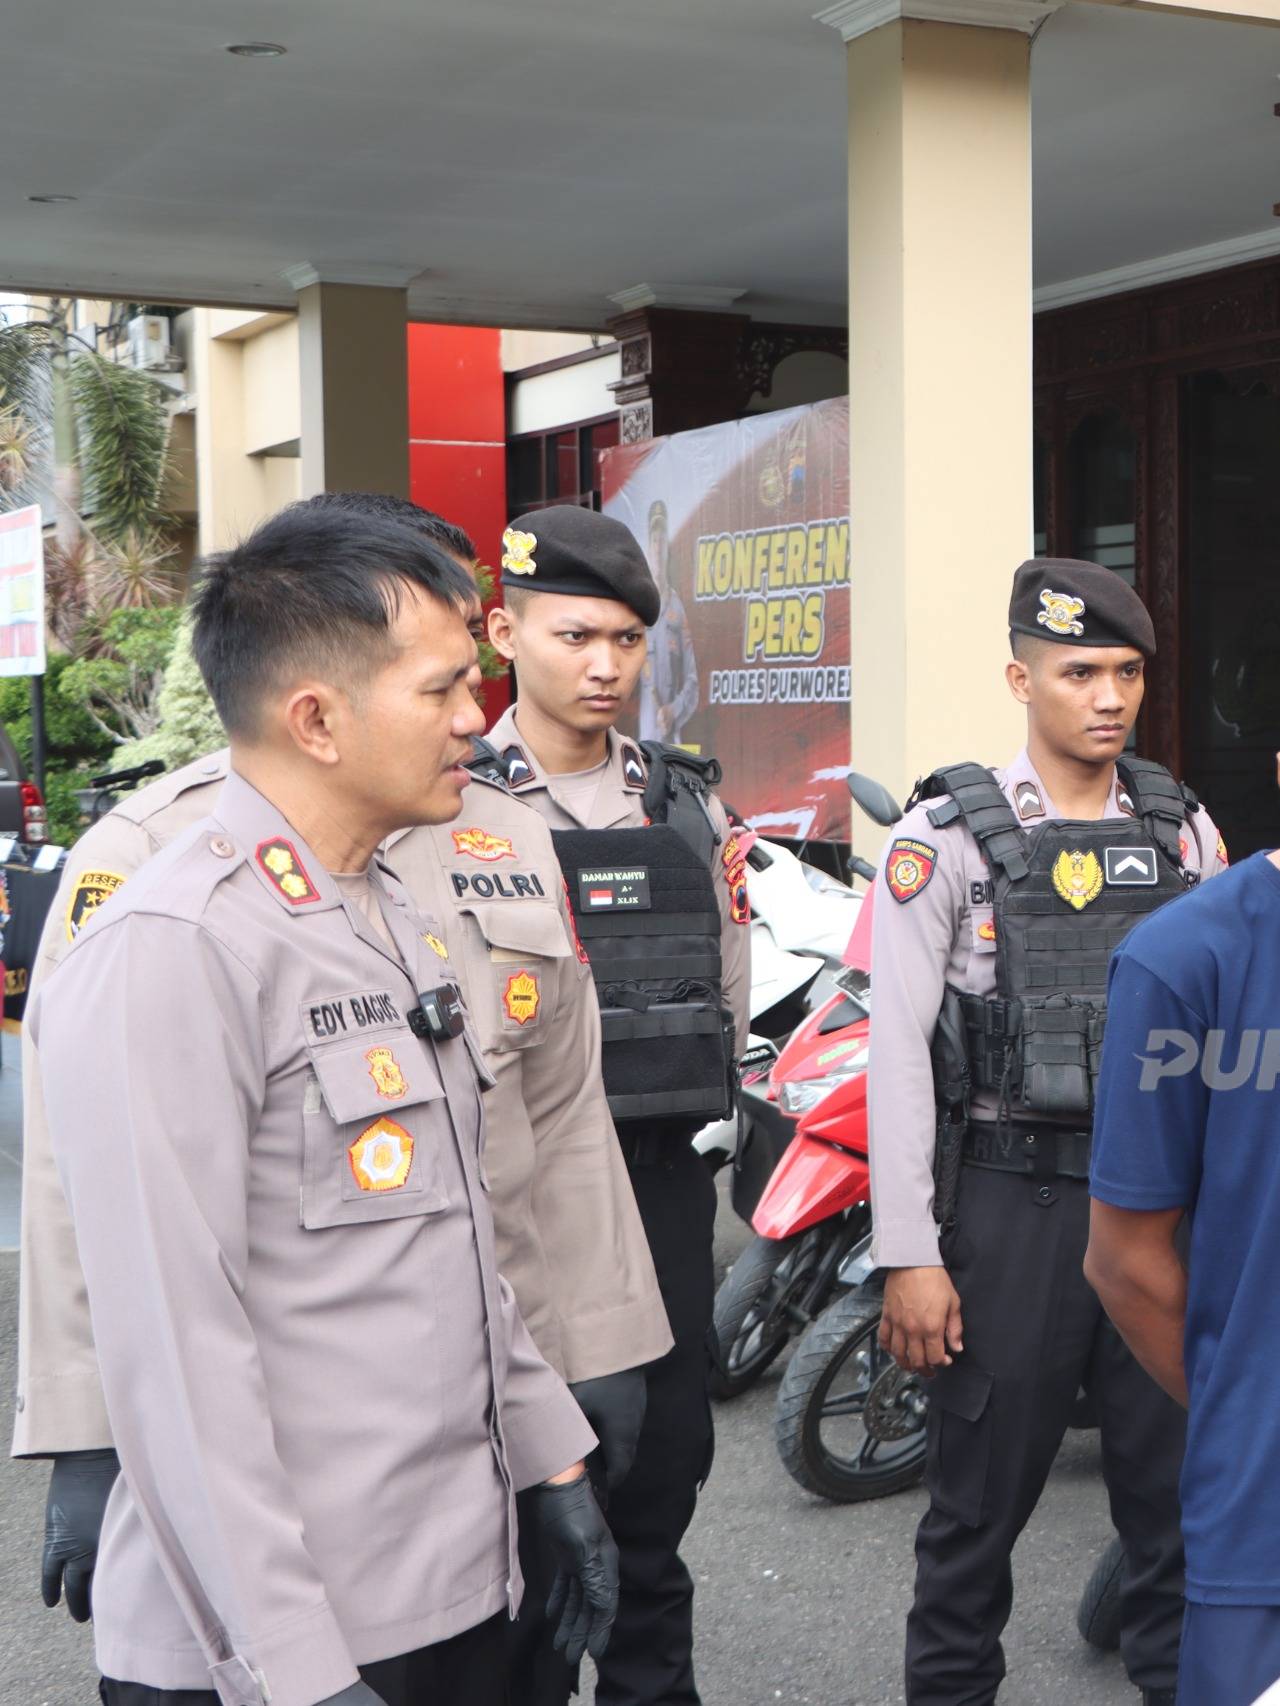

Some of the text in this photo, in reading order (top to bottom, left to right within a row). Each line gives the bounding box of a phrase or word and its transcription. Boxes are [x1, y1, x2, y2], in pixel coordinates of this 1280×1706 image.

[696, 519, 850, 598] KONFEREN
[745, 594, 824, 660] PERS
[712, 668, 850, 701] POLRES PURWORE
[451, 873, 545, 898] POLRI
[614, 871, 645, 881] WAHYU
[621, 885, 633, 893] A+
[617, 896, 639, 905] XLIX
[310, 992, 401, 1037] EDY BAGUS
